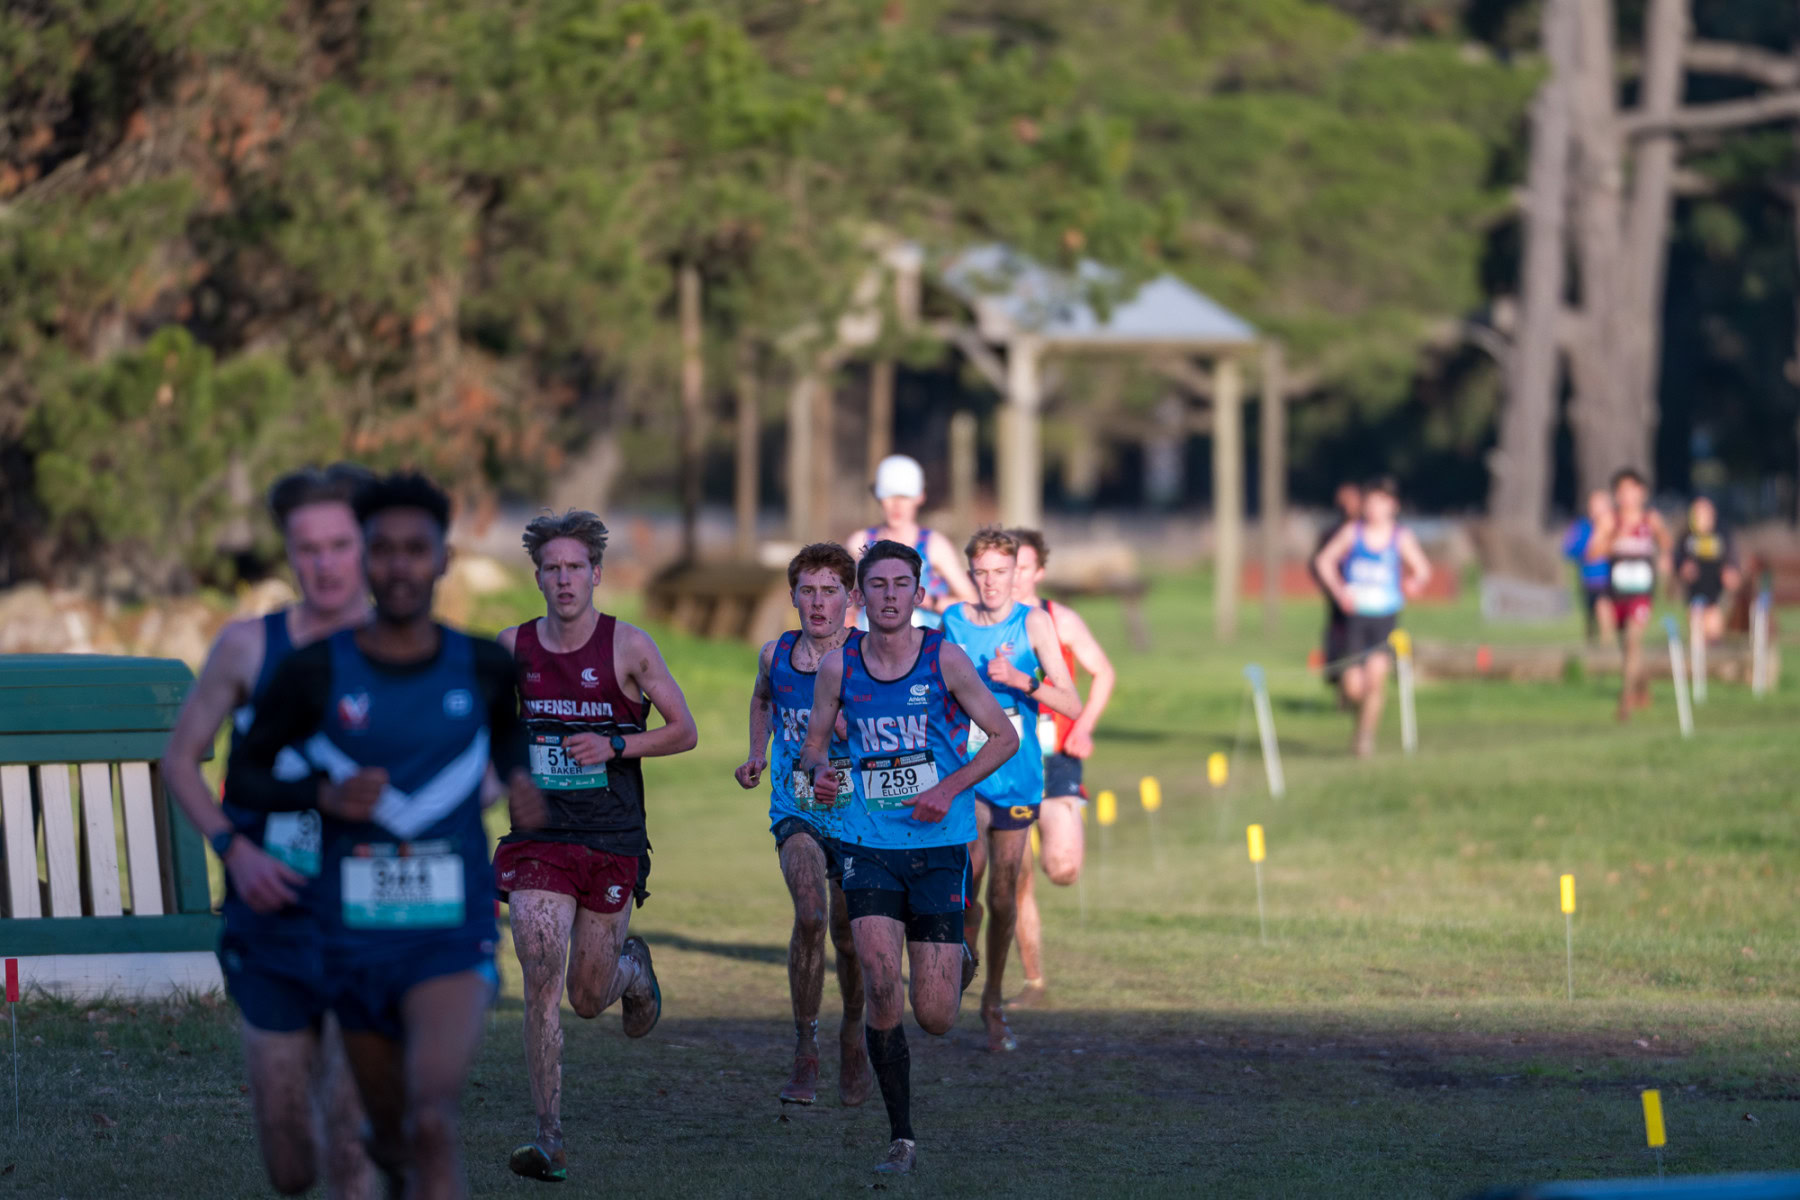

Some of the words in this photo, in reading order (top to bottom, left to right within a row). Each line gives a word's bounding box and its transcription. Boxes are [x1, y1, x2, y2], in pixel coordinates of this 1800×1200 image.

[856, 714, 928, 752] NSW
[551, 767, 583, 775] BAKER
[880, 768, 917, 789] 259
[882, 785, 920, 797] ELLIOTT
